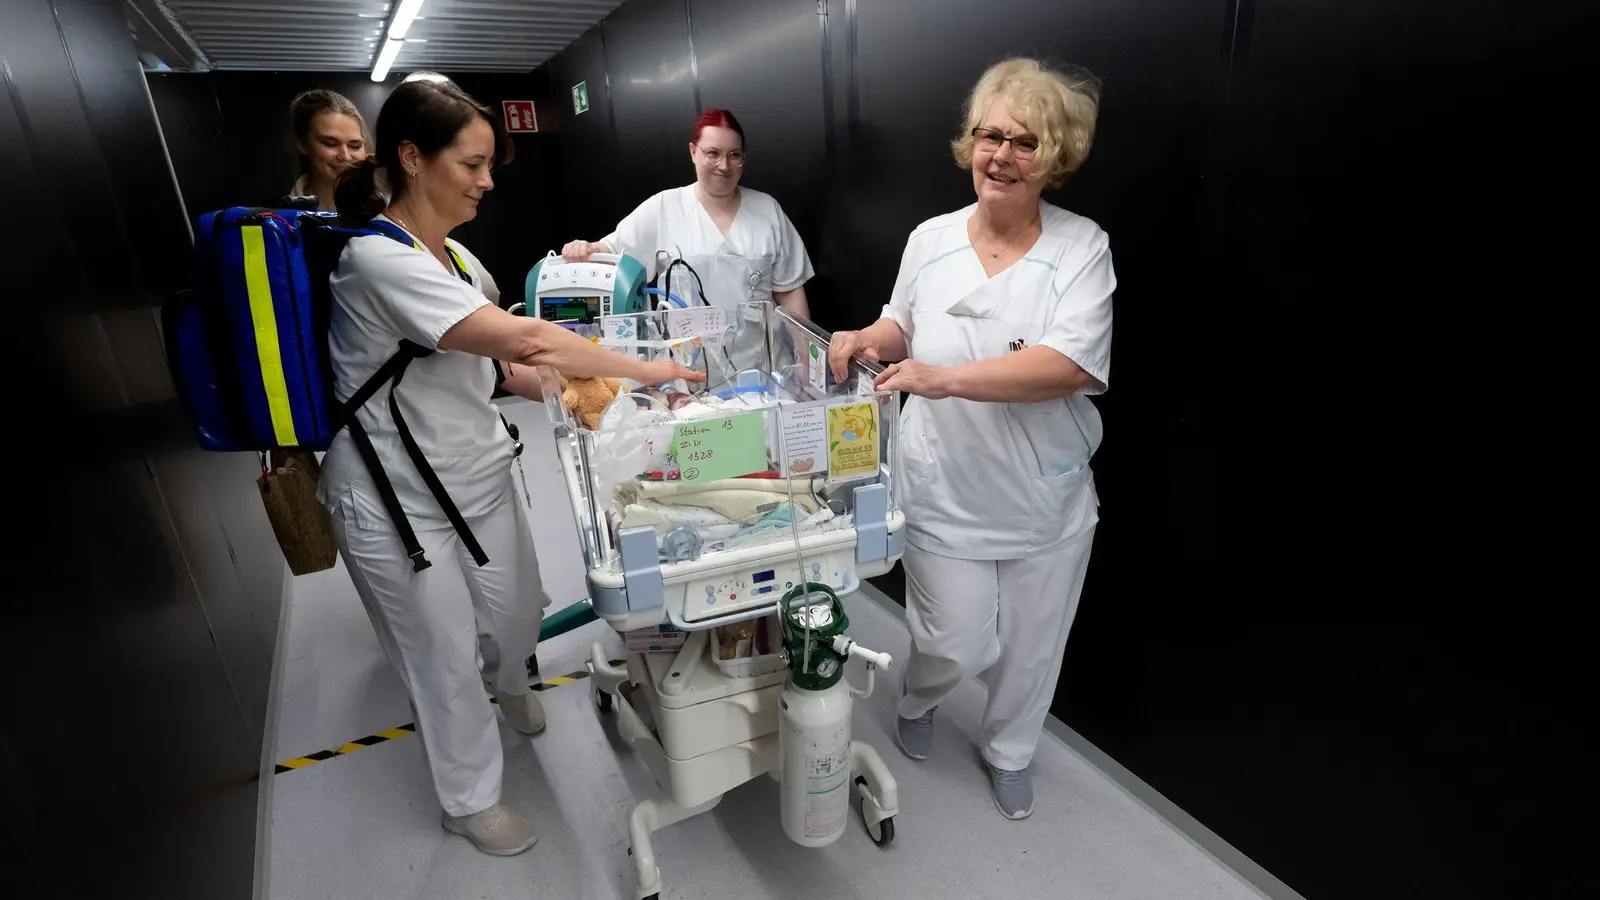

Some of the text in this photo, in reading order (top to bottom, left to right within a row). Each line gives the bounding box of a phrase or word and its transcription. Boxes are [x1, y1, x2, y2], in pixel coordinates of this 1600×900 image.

[679, 419, 734, 437] Station 13
[687, 449, 713, 461] 1328
